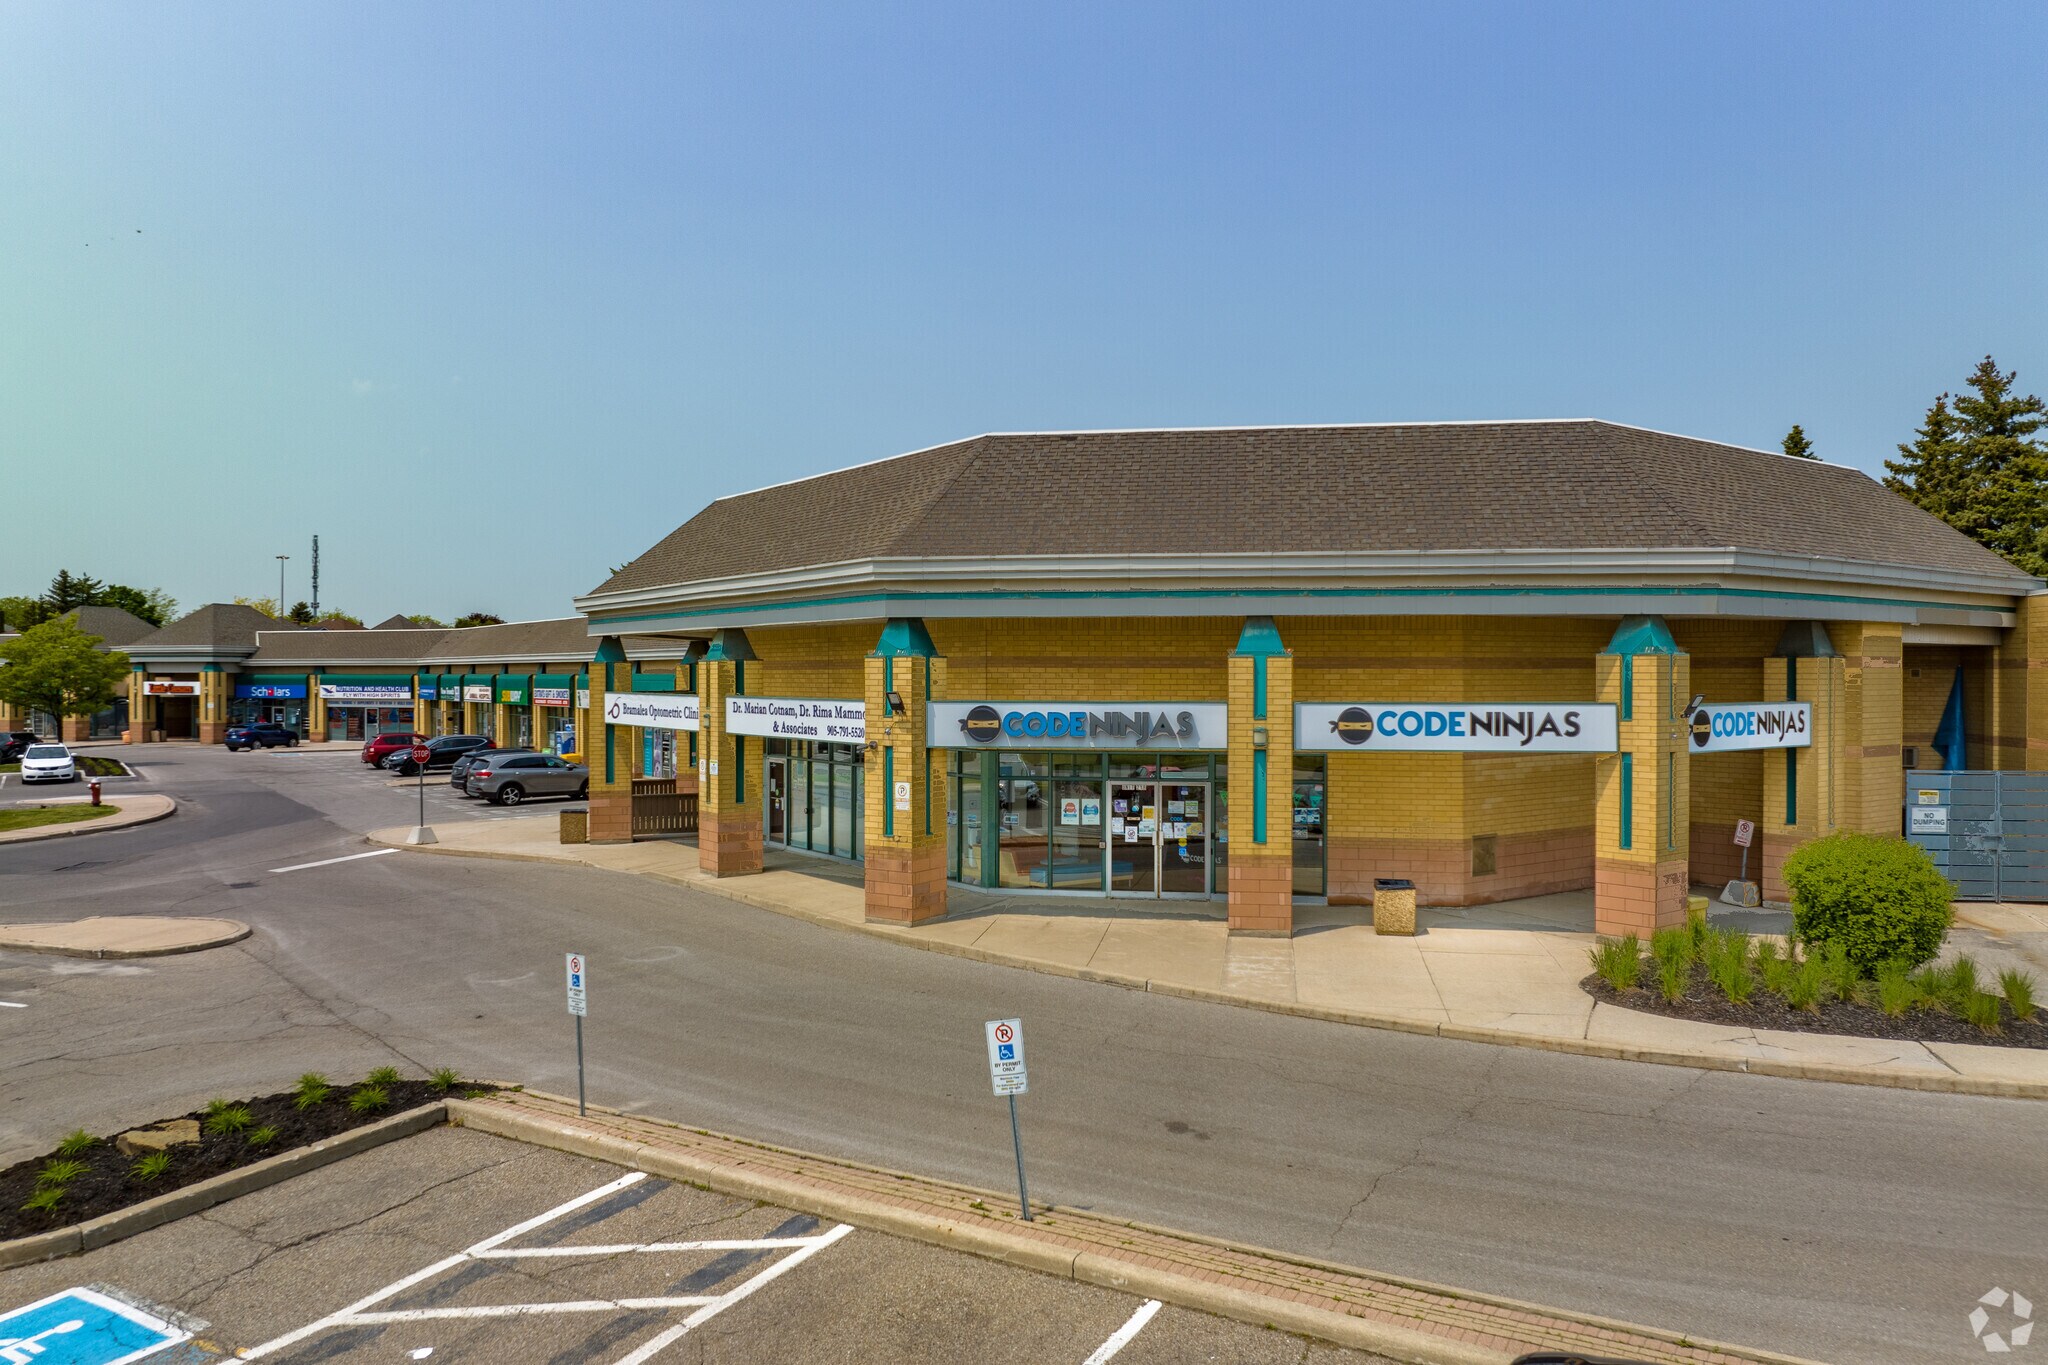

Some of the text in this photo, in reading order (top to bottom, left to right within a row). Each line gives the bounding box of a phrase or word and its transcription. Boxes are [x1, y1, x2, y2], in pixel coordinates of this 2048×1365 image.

[622, 703, 699, 720] Bramalea Optometric Clini
[732, 702, 742, 713] Dr.
[744, 702, 767, 715] Marian
[768, 703, 797, 719] Cotnam,
[799, 704, 811, 717] Dr.
[812, 705, 832, 718] Rima
[772, 721, 865, 738] & Associates 905-791-5520
[1002, 711, 1194, 746] CODE NINJAS
[1376, 710, 1581, 747] CODE NINJAS
[1712, 709, 1805, 742] CODE NINJAS
[414, 750, 429, 758] STOP
[1189, 854, 1205, 863] CODE
